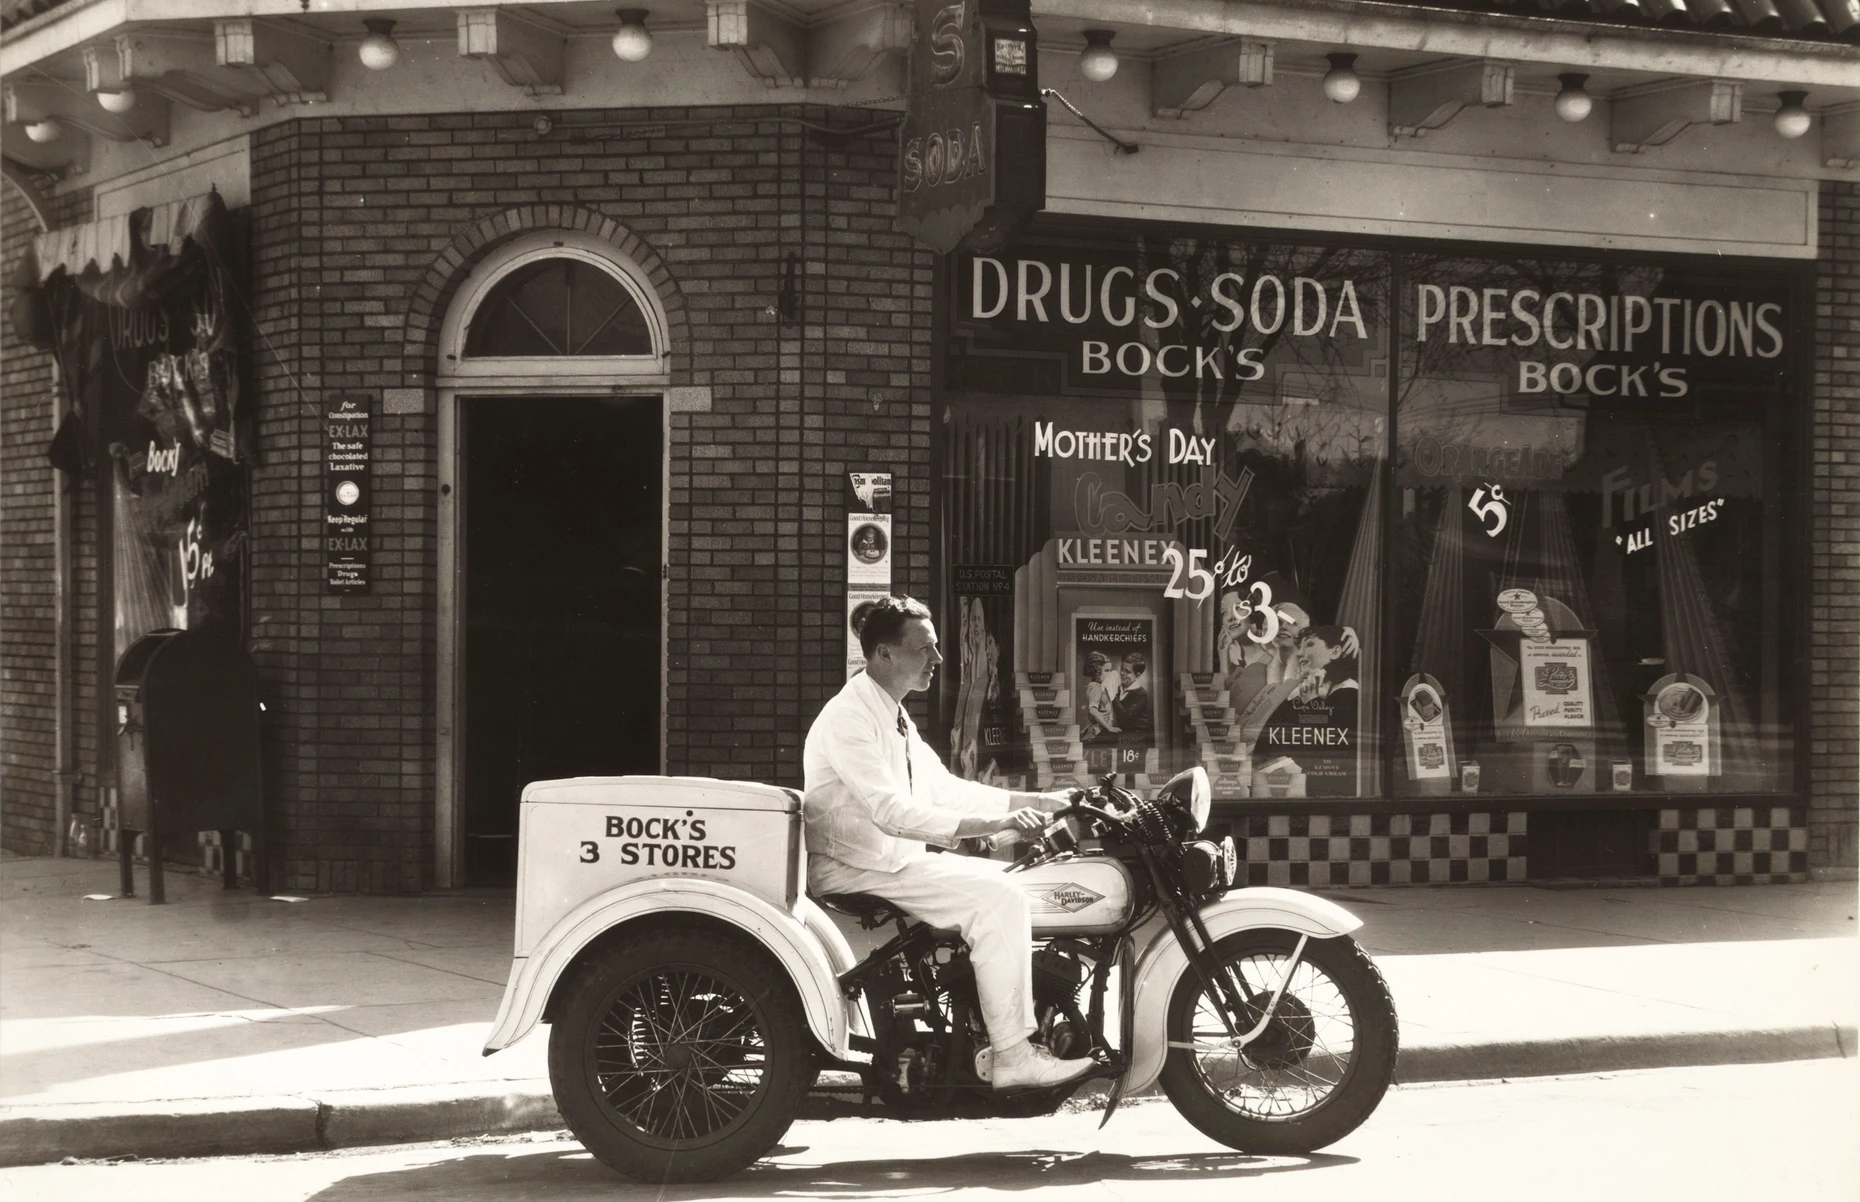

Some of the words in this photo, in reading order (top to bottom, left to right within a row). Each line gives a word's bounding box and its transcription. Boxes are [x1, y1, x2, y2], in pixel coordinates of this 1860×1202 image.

[903, 120, 987, 193] SODA
[972, 256, 1180, 329] DRUGS
[1210, 272, 1368, 340] SODA
[1416, 283, 1784, 359] PRESCRIPTIONS
[1081, 340, 1266, 381] BOCK'S
[1517, 360, 1689, 398] BOCK'S
[328, 411, 369, 420] Constipation
[340, 401, 356, 411] for
[331, 442, 346, 450] The
[347, 442, 363, 450] safe
[1034, 421, 1152, 468] MOTHER'S
[1168, 428, 1216, 466] DAY
[328, 452, 368, 460] chocolated
[1414, 435, 1563, 483] ORANGEADE
[329, 462, 365, 471] Laxative
[1074, 461, 1256, 542] Candy
[327, 515, 342, 524] Keep
[343, 514, 368, 525] Regular
[1057, 538, 1176, 565] KLEENEX
[328, 562, 366, 570] Prescriptions
[337, 570, 358, 578] Drugs
[1220, 550, 1252, 589] to
[955, 581, 990, 591] STATION
[1087, 621, 1103, 631] Use
[1105, 621, 1130, 631] instead
[1132, 622, 1142, 632] of
[1081, 633, 1148, 643] HANDKERCHIEFS
[1268, 727, 1350, 746] KLEENEX
[605, 815, 706, 841] BOCK'S
[580, 841, 600, 864] 3
[621, 842, 737, 871] STORES
[1060, 896, 1095, 906] DAVIDSON
